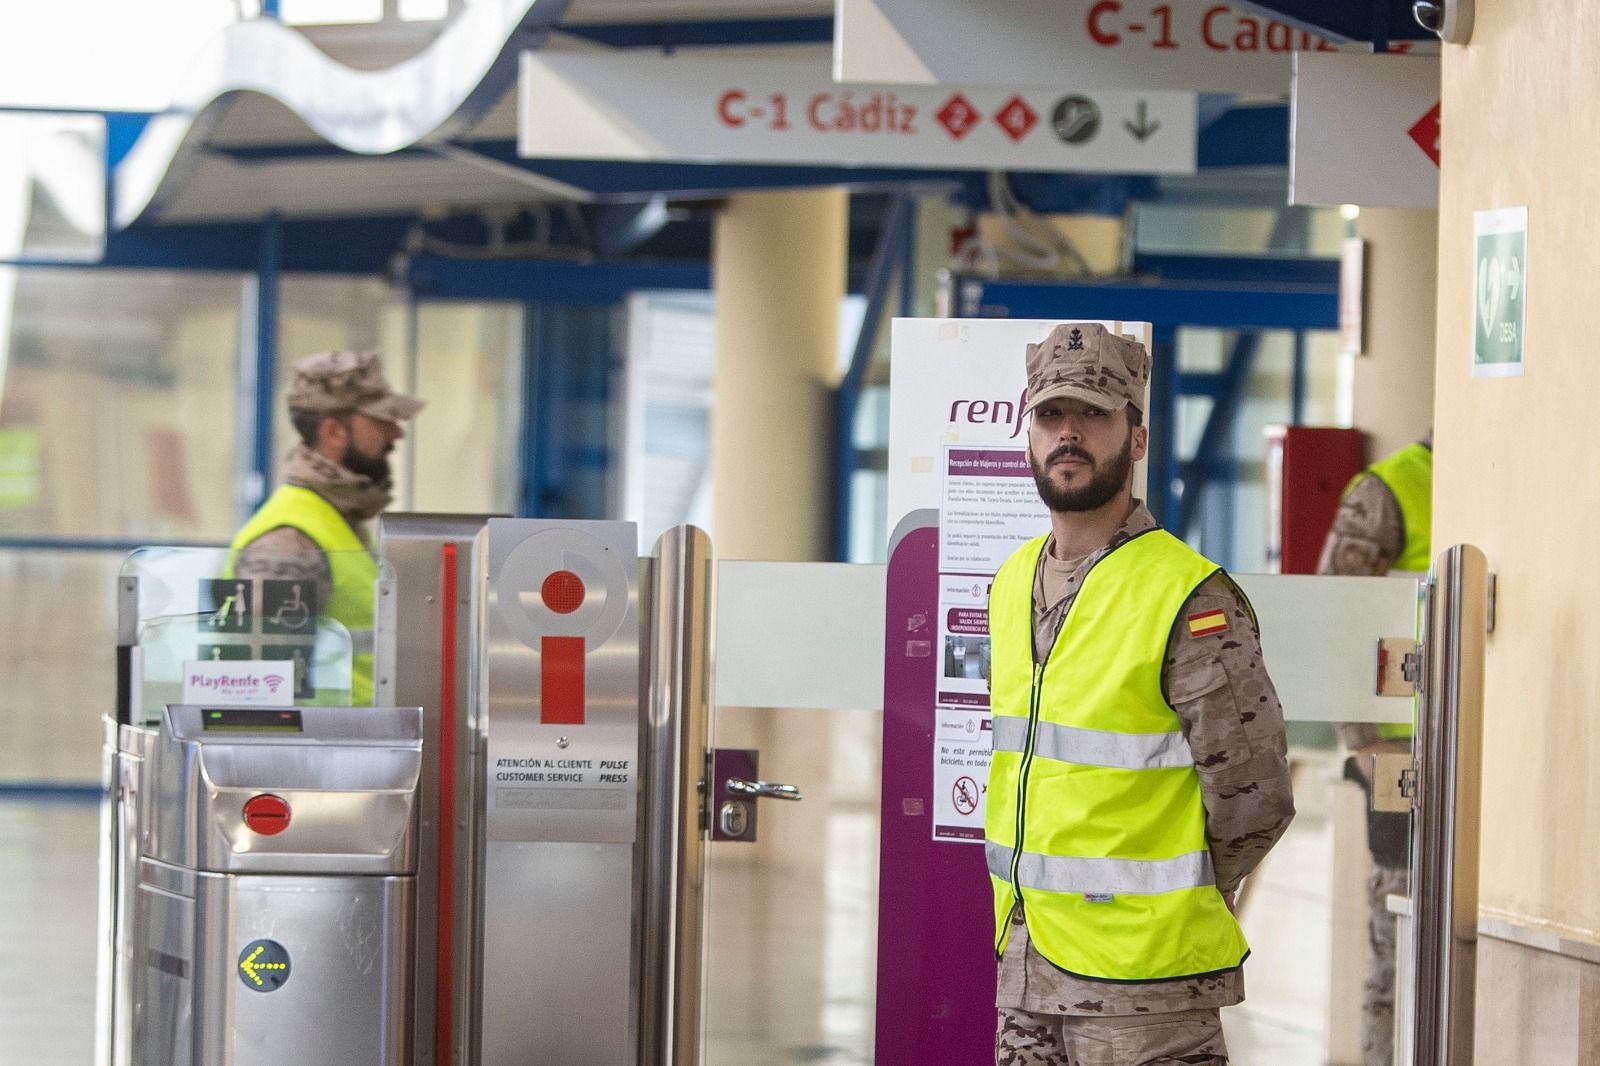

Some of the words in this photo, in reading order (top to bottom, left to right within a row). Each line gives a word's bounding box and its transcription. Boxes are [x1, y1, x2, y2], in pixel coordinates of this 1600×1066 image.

[1087, 0, 1180, 49] C-1
[717, 88, 791, 131] C-1
[806, 92, 918, 134] Cádiz
[1500, 322, 1517, 343] DESA
[949, 386, 1028, 439] renf
[949, 458, 972, 468] Recepción
[973, 459, 979, 467] de
[980, 459, 997, 469] Viajeros
[1002, 460, 1018, 468] control
[1020, 460, 1026, 468] de
[191, 675, 260, 690] PlayRenfe
[941, 746, 949, 754] No
[968, 747, 992, 756] permitid
[496, 758, 541, 769] ATENCIÓN
[544, 760, 554, 769] AL
[557, 760, 593, 769] CLIENTE
[600, 760, 629, 770] PULSE
[974, 759, 987, 767] todo
[496, 772, 545, 782] CUSTOMER
[547, 773, 584, 782] SERVICE
[599, 774, 628, 783] PRESS
